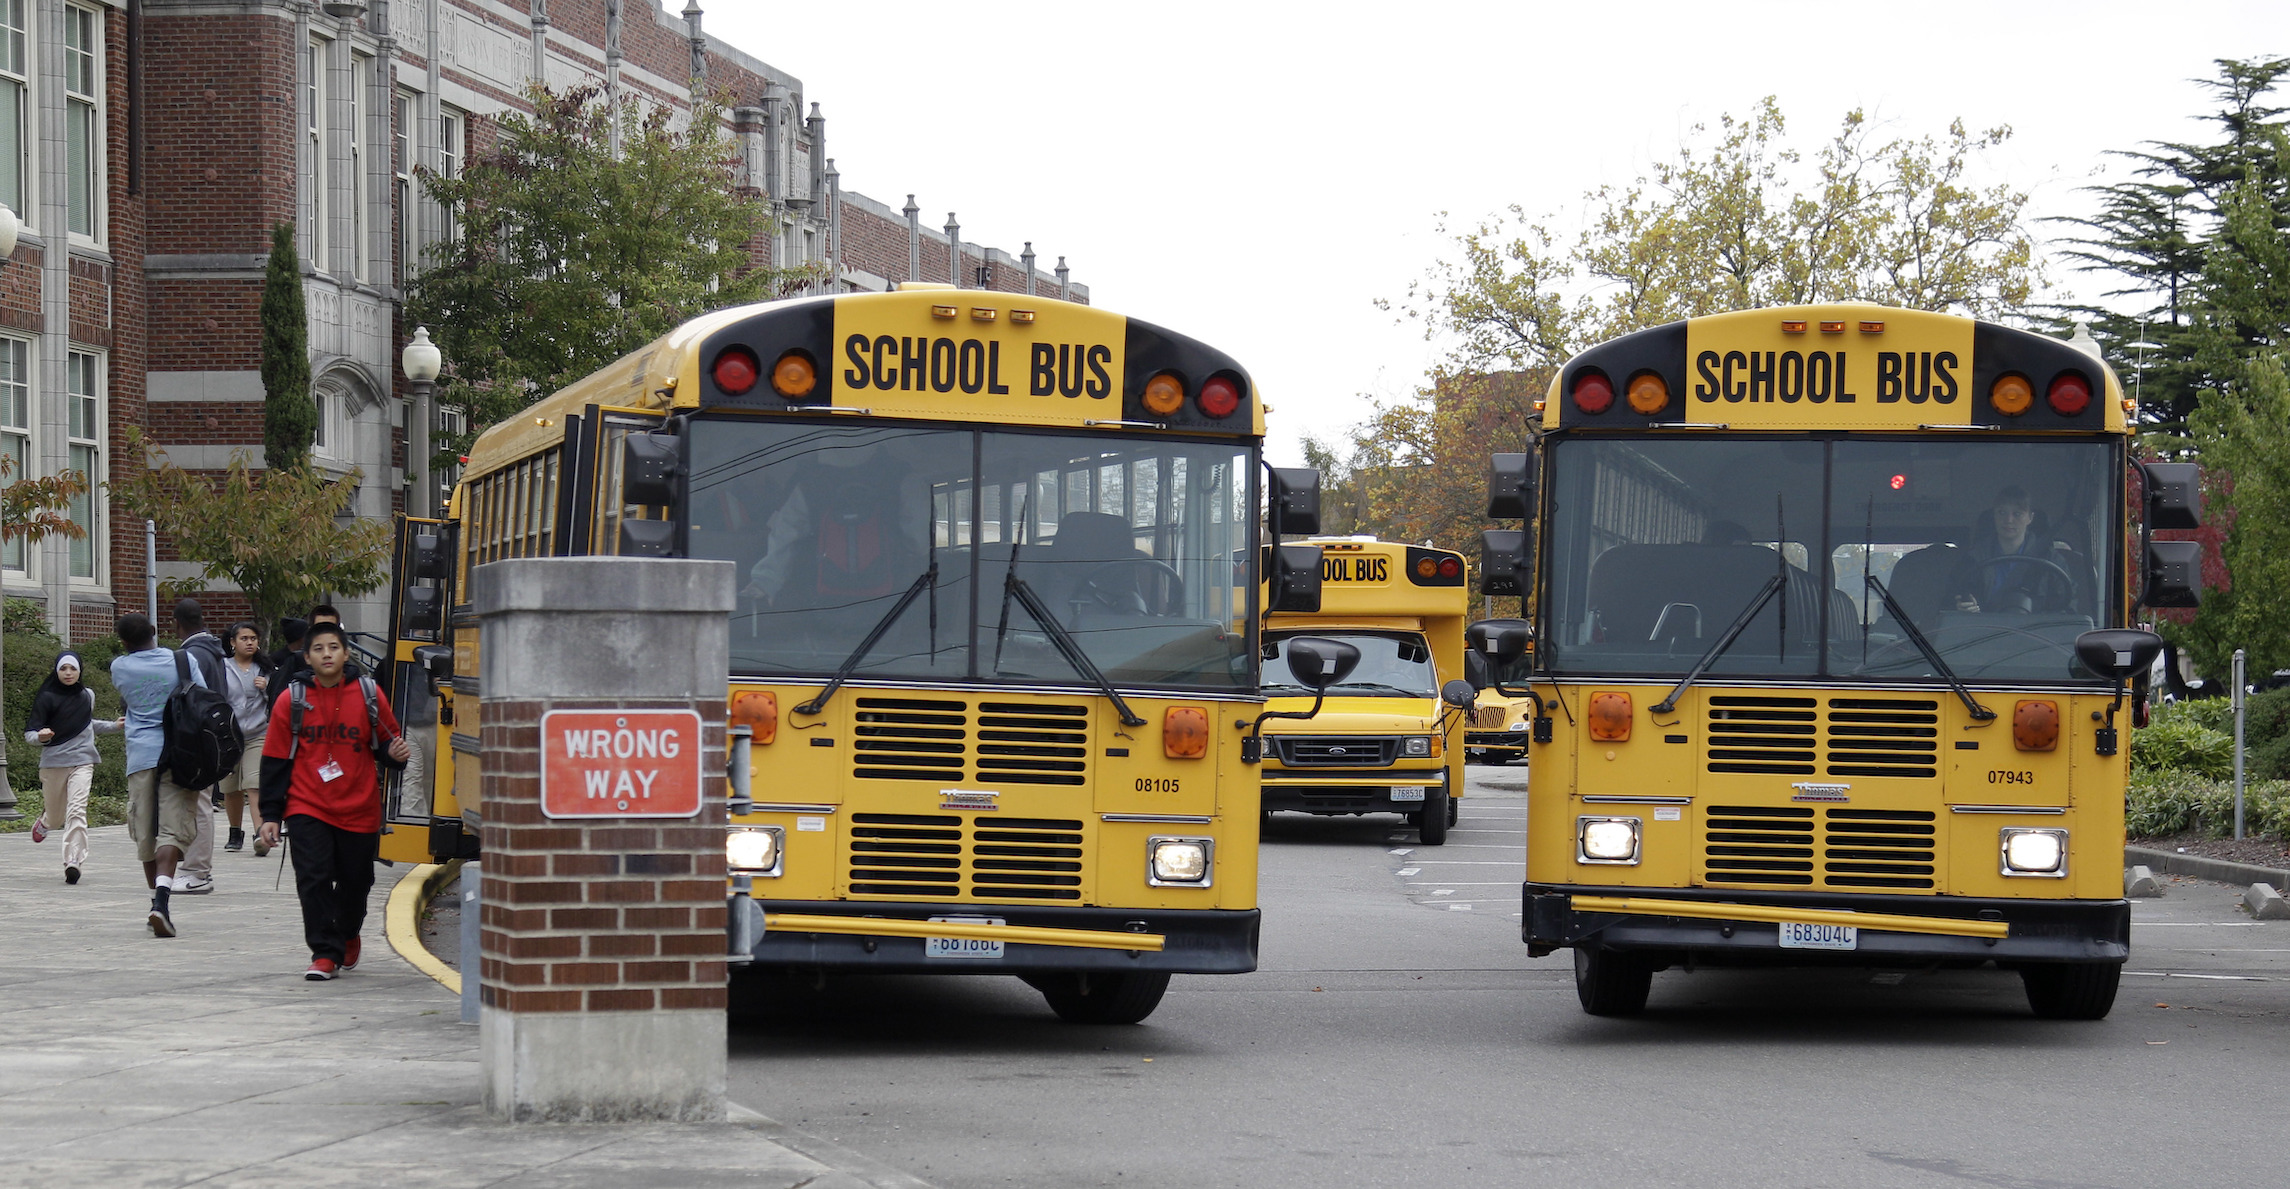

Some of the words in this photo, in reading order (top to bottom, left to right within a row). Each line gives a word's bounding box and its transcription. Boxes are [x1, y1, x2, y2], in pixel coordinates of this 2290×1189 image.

[845, 333, 1009, 395] SCHOOL
[1030, 342, 1112, 400] BUS
[1695, 350, 1856, 404] SCHOOL
[1876, 351, 1959, 405] BUS
[1356, 558, 1387, 581] BUS
[564, 729, 680, 759] WRONG
[584, 769, 659, 799] WAY
[1135, 778, 1180, 793] 08105
[1988, 770, 2033, 785] 07943
[1794, 923, 1852, 943] 68304C
